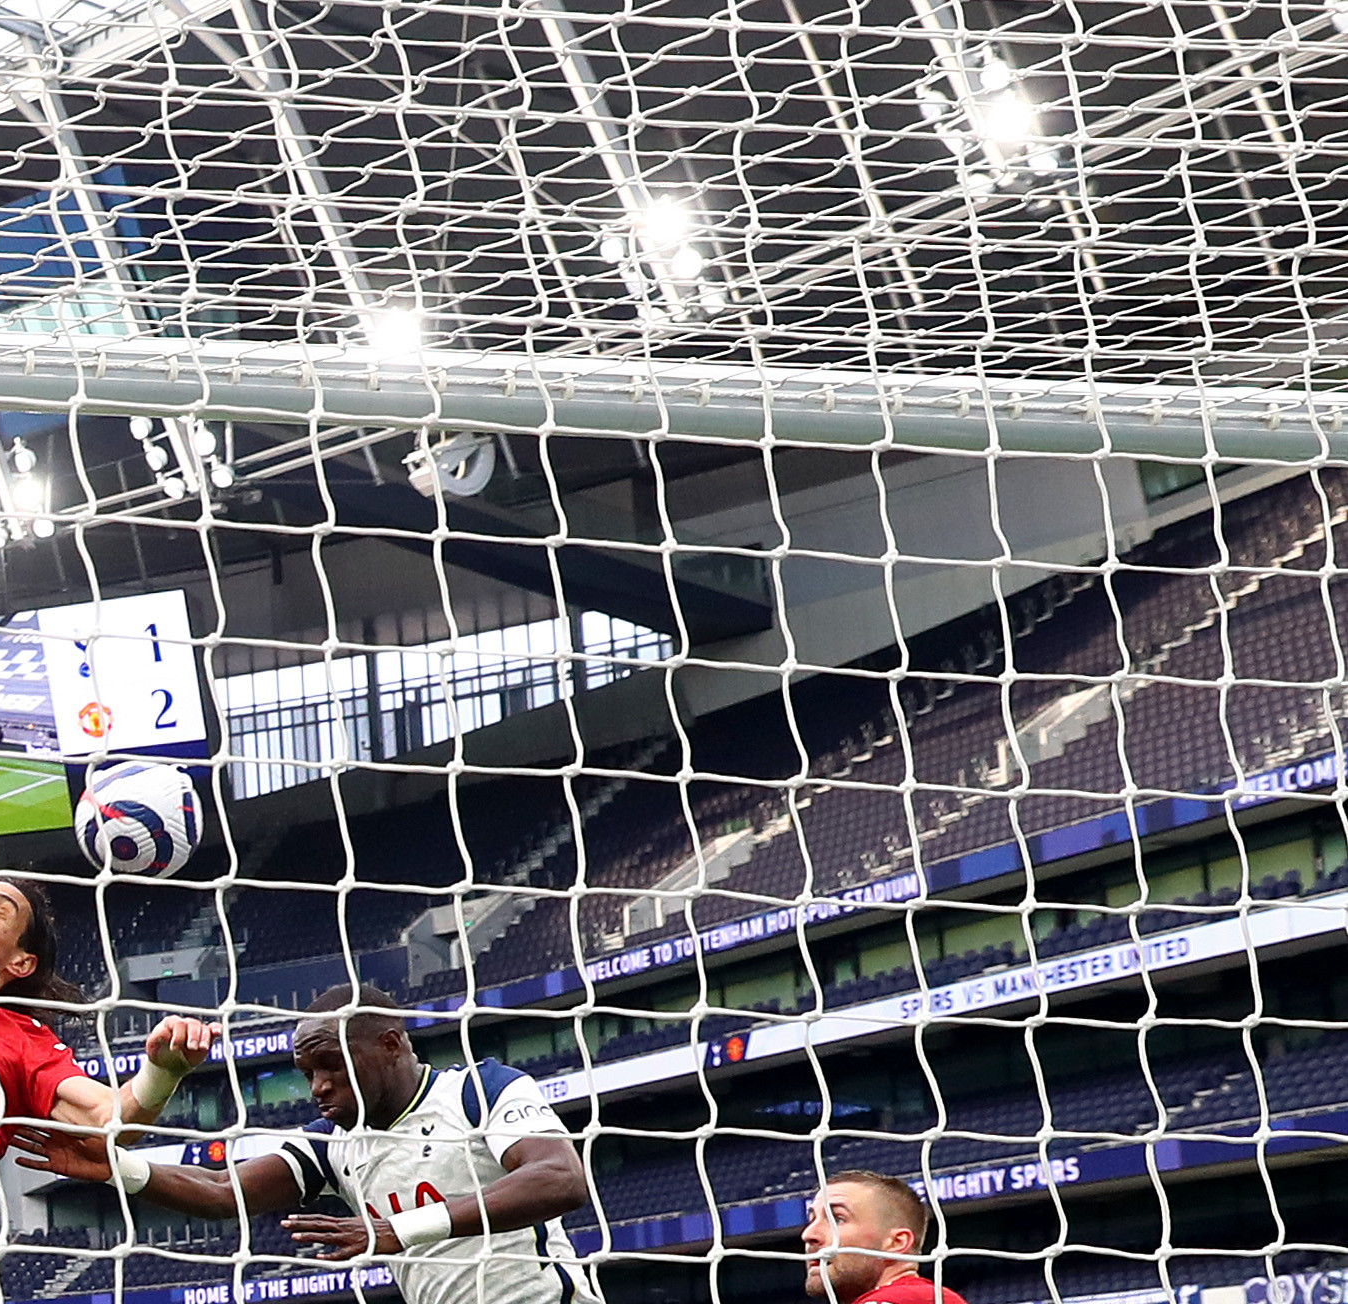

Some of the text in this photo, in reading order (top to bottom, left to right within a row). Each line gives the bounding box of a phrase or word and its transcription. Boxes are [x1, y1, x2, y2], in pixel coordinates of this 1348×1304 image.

[144, 623, 162, 662] 1
[151, 688, 178, 729] 2
[587, 953, 651, 982] WELCOME
[652, 945, 672, 964] TO
[675, 917, 764, 958] TOTENHAM
[901, 989, 953, 1020] SPRS
[963, 982, 984, 1005] VS
[933, 1168, 1006, 1201] MIGHTY
[235, 1282, 254, 1300] F
[258, 1278, 288, 1299] THE
[291, 1272, 346, 1296] MIGHTY
